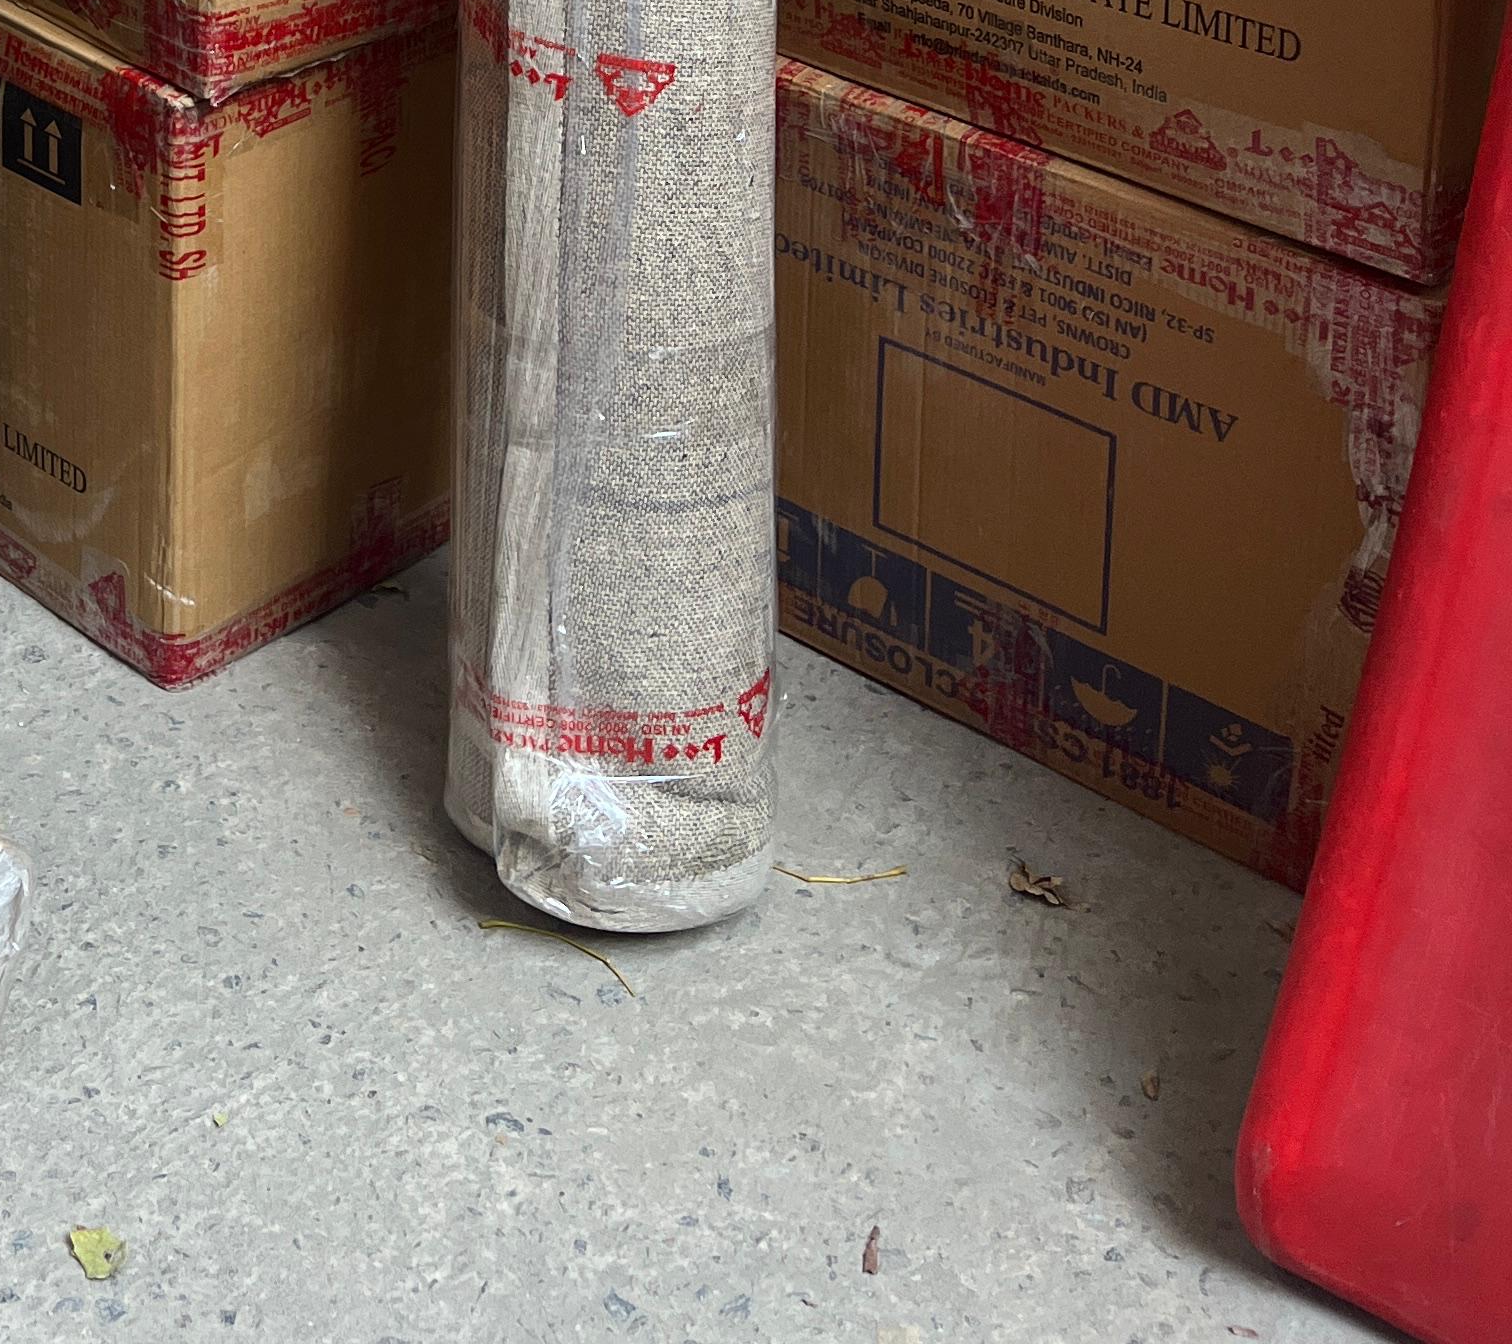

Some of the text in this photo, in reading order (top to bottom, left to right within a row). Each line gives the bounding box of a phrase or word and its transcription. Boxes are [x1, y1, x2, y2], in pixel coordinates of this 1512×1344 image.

[958, 2, 975, 19] 70
[978, 8, 1024, 37] Village
[1096, 47, 1144, 76] NH-24
[1065, 58, 1128, 94] Pradesh,
[1132, 79, 1168, 104] India
[1019, 304, 1047, 328] PET
[1038, 289, 1078, 316] 9001
[920, 292, 1119, 401] Industries
[1052, 318, 1131, 360] CROWNS,
[1161, 311, 1215, 344] SP-32,
[1131, 380, 1239, 443] AMD
[3, 423, 87, 494] LIMITED
